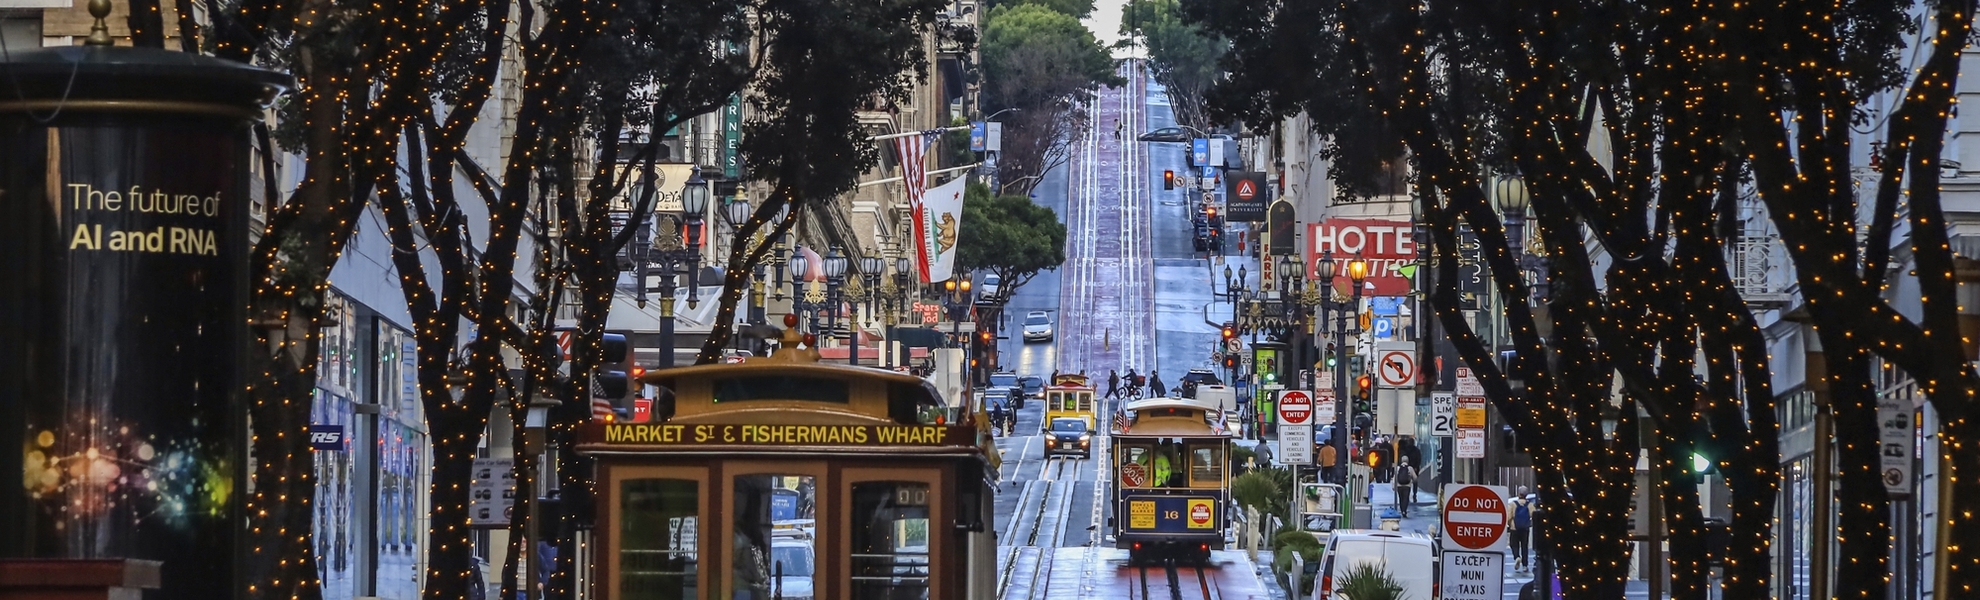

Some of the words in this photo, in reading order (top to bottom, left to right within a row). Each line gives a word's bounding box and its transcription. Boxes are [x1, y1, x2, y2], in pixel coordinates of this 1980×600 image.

[728, 92, 737, 167] RNES
[67, 183, 122, 211] The
[129, 185, 199, 215] future
[203, 191, 221, 217] of
[69, 223, 102, 250] AI
[108, 226, 163, 252] and
[170, 227, 218, 256] RNA
[1315, 225, 1413, 254] HOTE
[1434, 397, 1452, 405] SPE
[310, 432, 341, 443] RS
[605, 425, 685, 442] MARKET
[742, 425, 868, 443] FISHERMANS
[876, 426, 947, 443] WHARF
[1457, 430, 1465, 438] NO
[1124, 467, 1144, 485] STOP
[1454, 498, 1469, 508] DO
[1476, 499, 1498, 509] NOT
[1164, 510, 1179, 520] 16
[1457, 526, 1492, 537] ENTER
[1455, 556, 1490, 566] EXCEPT
[1460, 570, 1485, 581] MUNI
[1459, 584, 1485, 595] TAXIS
